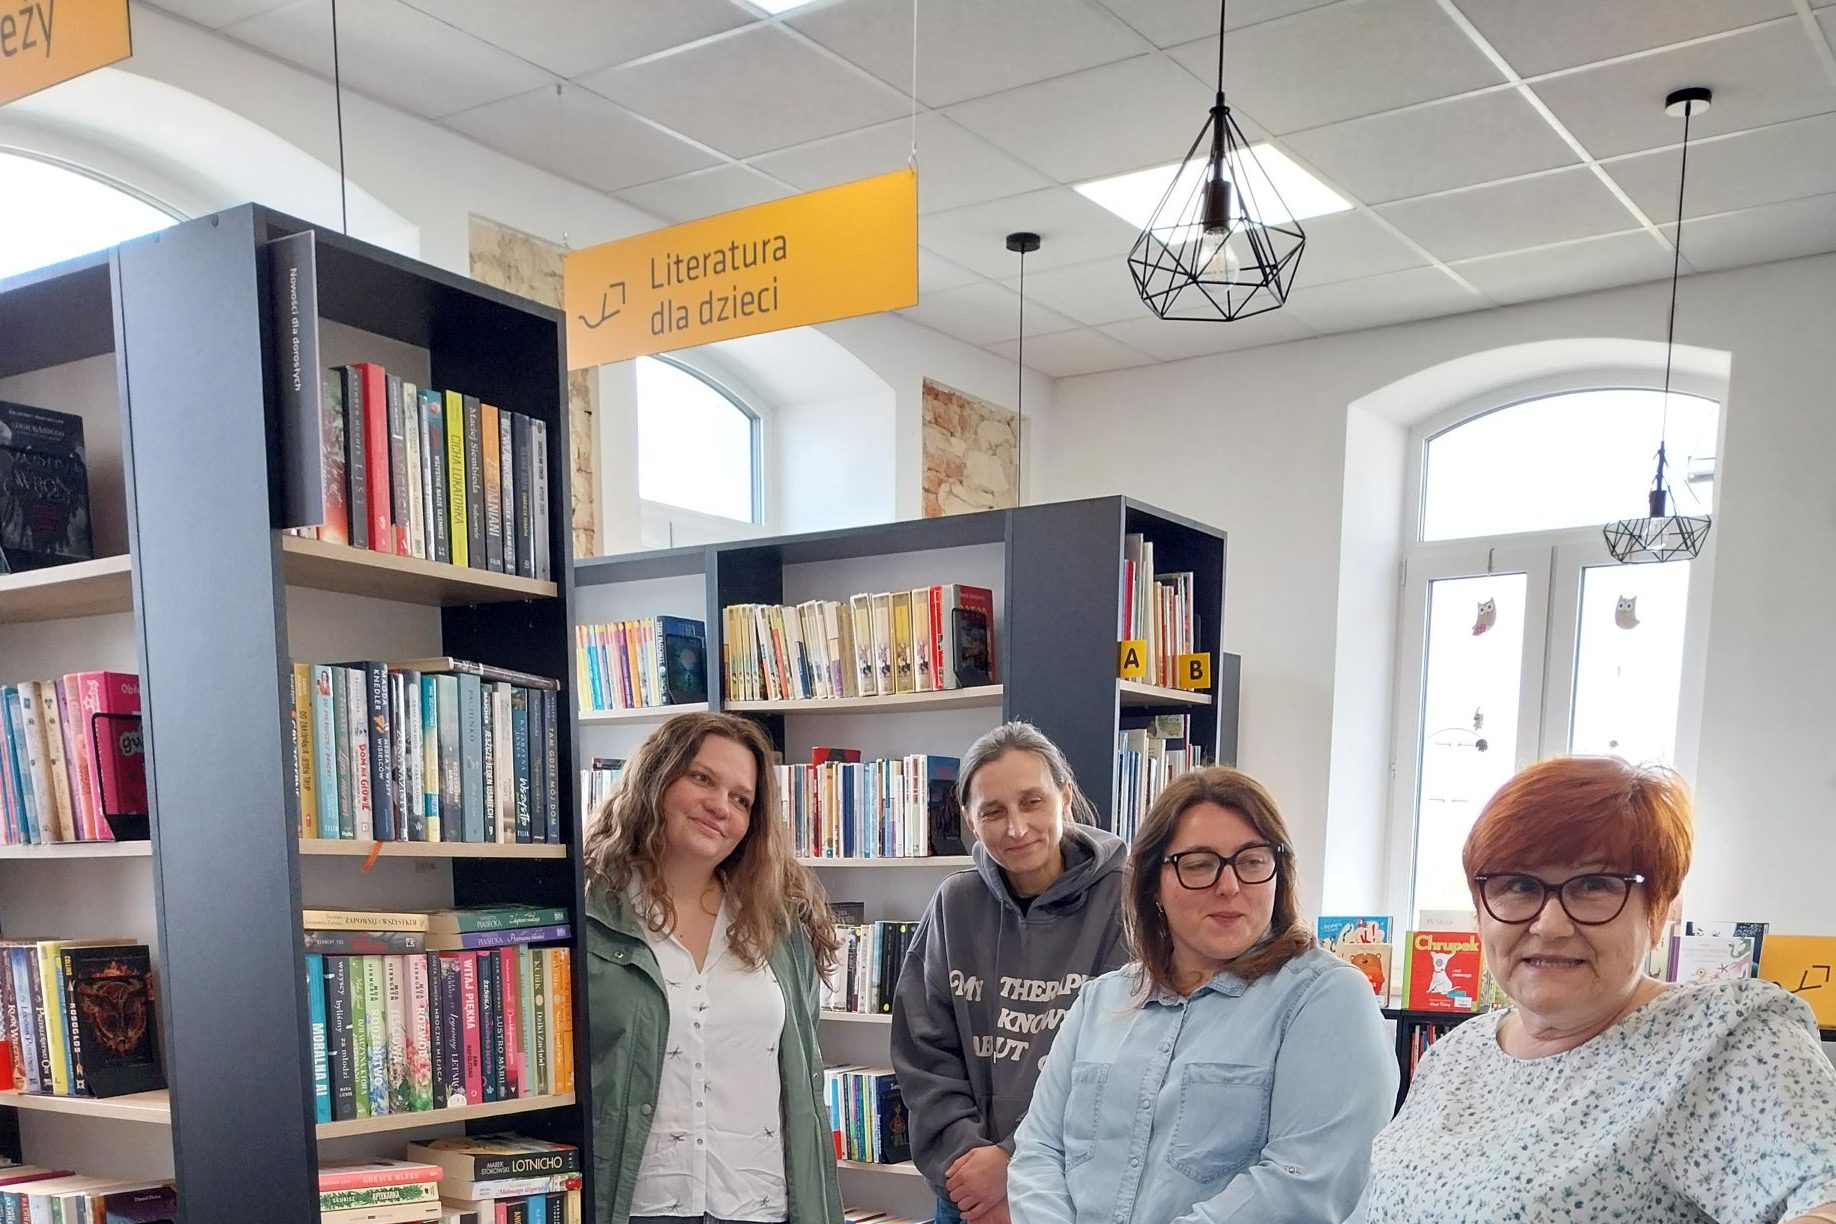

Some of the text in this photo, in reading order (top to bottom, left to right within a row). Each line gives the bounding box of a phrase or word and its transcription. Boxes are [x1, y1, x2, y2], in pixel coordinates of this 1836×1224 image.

[650, 233, 788, 290] Literatura
[290, 267, 299, 314] Nowości
[650, 276, 779, 336] dla dzieci
[292, 337, 301, 391] dorosłych
[468, 407, 480, 494] Maciej Siembieda
[450, 434, 464, 524] CICHA LOKATORKA
[434, 455, 445, 540] WSZYSTKIE NASZE TAJEMNICE
[1124, 648, 1140, 669] A
[1189, 659, 1203, 681] B
[373, 669, 381, 710] KNEDLER
[299, 711, 308, 719] DO
[299, 720, 310, 754] ZAKOPANIA
[484, 729, 492, 760] JESZCZE
[302, 756, 310, 775] JEDEN
[359, 744, 367, 766] DOM
[376, 738, 385, 780] WISIELCÓW
[484, 761, 493, 785] JEDEN
[486, 786, 494, 819] UŚMIECH
[518, 778, 530, 826] Wszystko
[1415, 934, 1480, 954] Chrupek
[463, 959, 474, 990] WITAJ
[949, 969, 983, 1001] MY
[335, 1000, 344, 1033] byliśmy
[341, 1037, 346, 1047] za
[464, 993, 475, 1029] PIĘKNA
[536, 1011, 545, 1033] Dziki
[312, 1023, 327, 1096] MORALNA AI
[435, 1048, 443, 1082] MIEJSCA
[537, 1034, 545, 1066] Zachód
[480, 1166, 510, 1176] STOKOWSKI
[486, 1161, 504, 1169] MAREK
[512, 1156, 563, 1172] LOTNICHO
